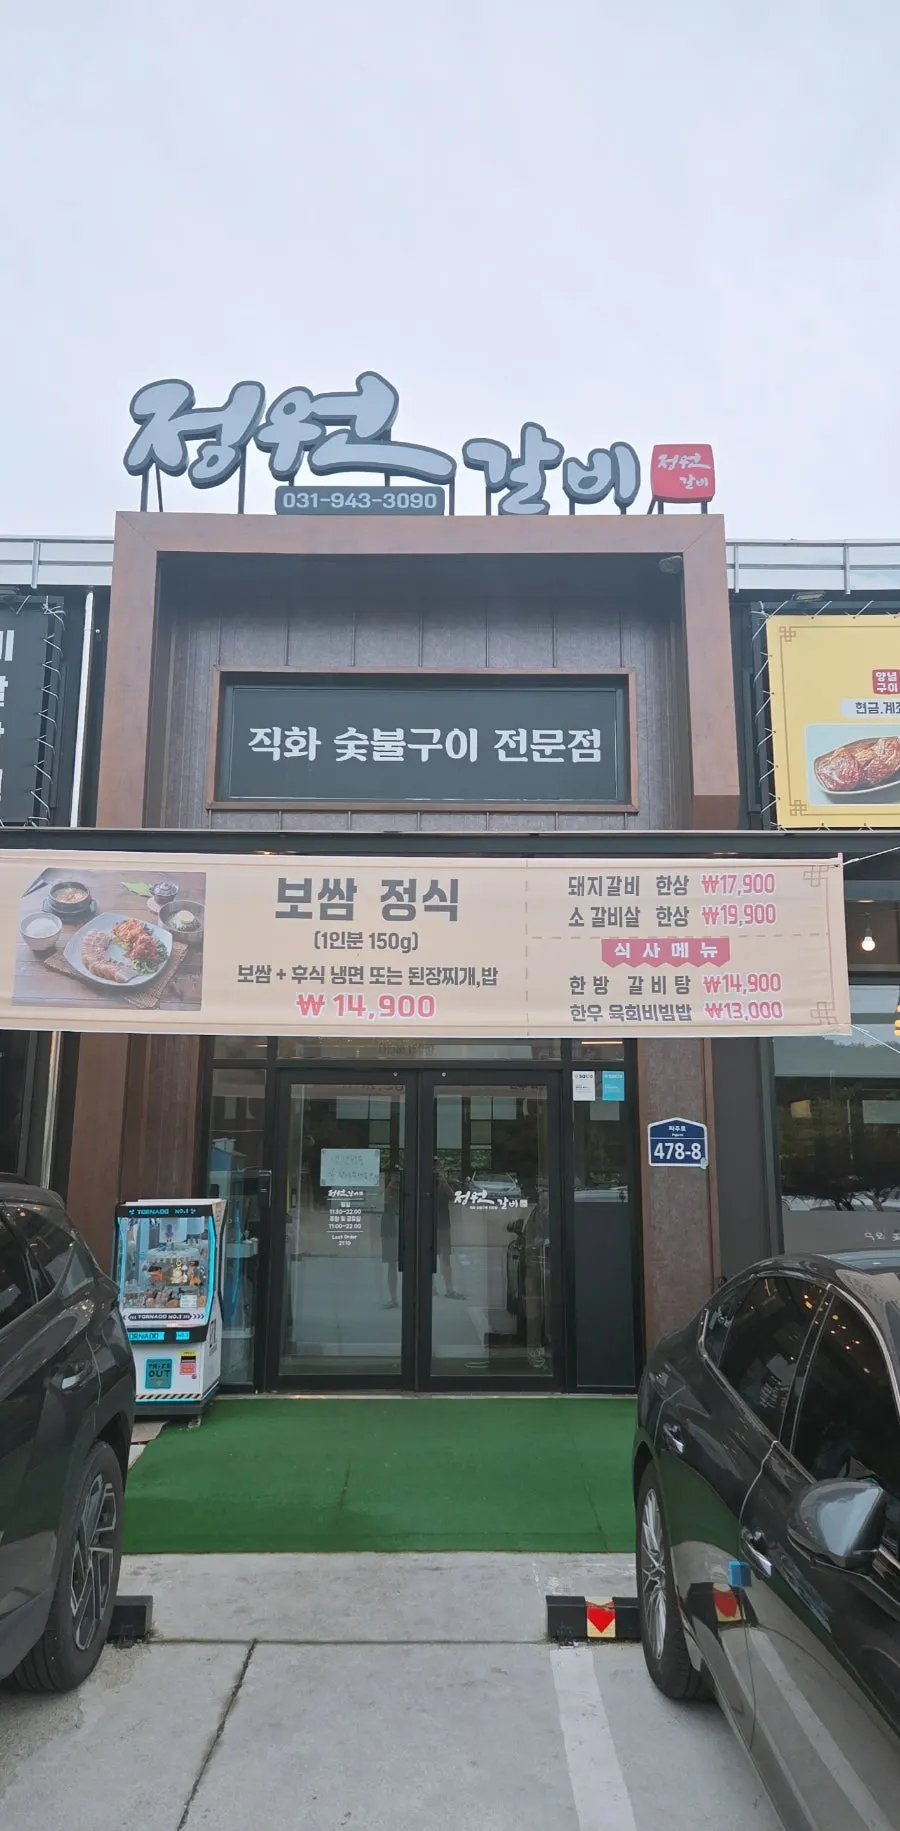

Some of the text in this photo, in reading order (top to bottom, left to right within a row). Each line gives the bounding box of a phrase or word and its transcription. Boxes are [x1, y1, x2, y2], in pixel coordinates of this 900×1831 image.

[123, 371, 641, 515] 정원 갈비
[657, 452, 711, 470] 정원
[679, 473, 709, 489] 갈비
[282, 493, 438, 510] 031-943-3090
[875, 671, 897, 682] 양념
[876, 682, 898, 692] 구이
[247, 726, 601, 763] 직화 숯불구이 전문점
[568, 874, 775, 897] 돼지갈비 한상 ₩17,900
[275, 877, 459, 922] 보쌈 정식
[568, 904, 777, 928] 소 갈비살 한상 ₩19,900
[314, 931, 419, 953] (1인분 150g)
[237, 965, 272, 984] 보쌈
[291, 965, 325, 984] 후식
[330, 966, 364, 985] 냉면
[369, 966, 403, 985] 또는
[408, 967, 499, 988] 된장찌개,밥
[703, 973, 782, 995] ₩14,900
[569, 1001, 783, 1022] 한우 육회비빔밥 ₩13,000
[654, 1142, 702, 1160] 478-8
[454, 1189, 495, 1205] 정원
[497, 1197, 518, 1210] 갈비
